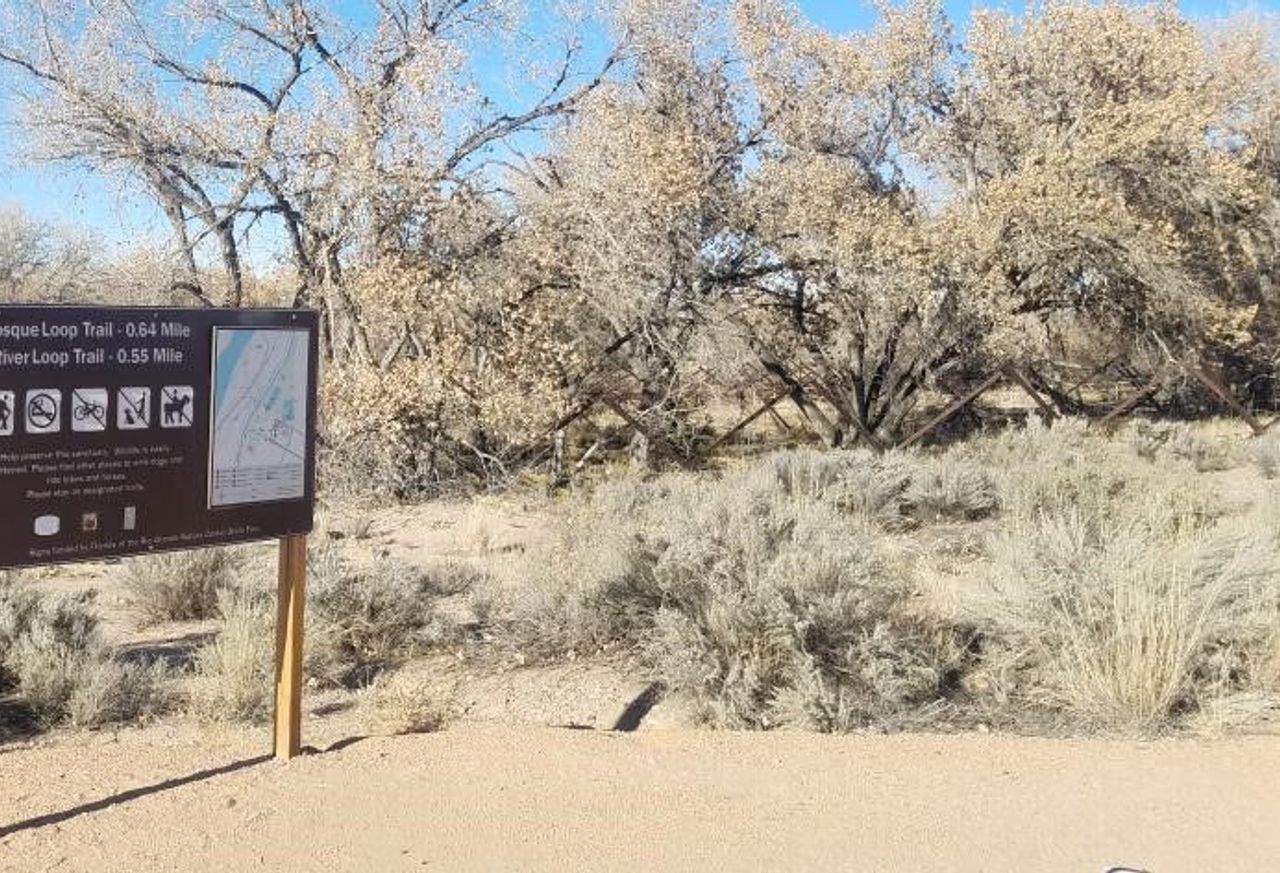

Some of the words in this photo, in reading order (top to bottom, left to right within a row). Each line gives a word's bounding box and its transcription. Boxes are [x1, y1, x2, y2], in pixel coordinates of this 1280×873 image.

[42, 321, 78, 340] Loop
[81, 321, 113, 338] Trail
[125, 321, 157, 338] 0.64
[160, 321, 191, 338] Mile
[32, 347, 69, 367] Loop
[72, 347, 105, 364] Trail
[117, 347, 150, 364] 0.55
[153, 347, 183, 363] Mile
